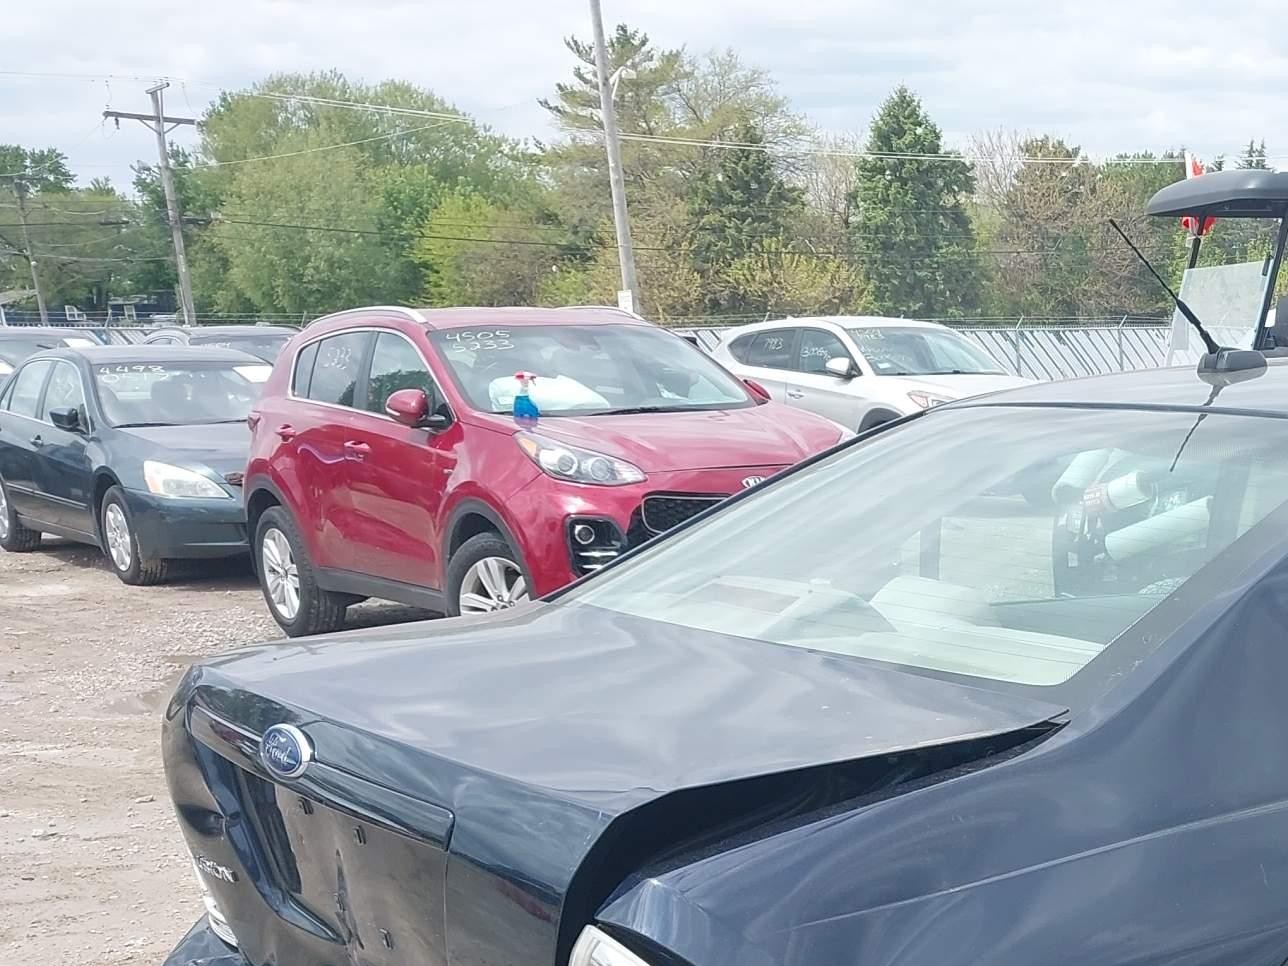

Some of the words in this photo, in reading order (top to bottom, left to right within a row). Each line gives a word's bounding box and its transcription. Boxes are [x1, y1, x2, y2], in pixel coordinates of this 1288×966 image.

[445, 329, 512, 342] 4505
[452, 339, 515, 353] 5233
[99, 364, 166, 375] 4498
